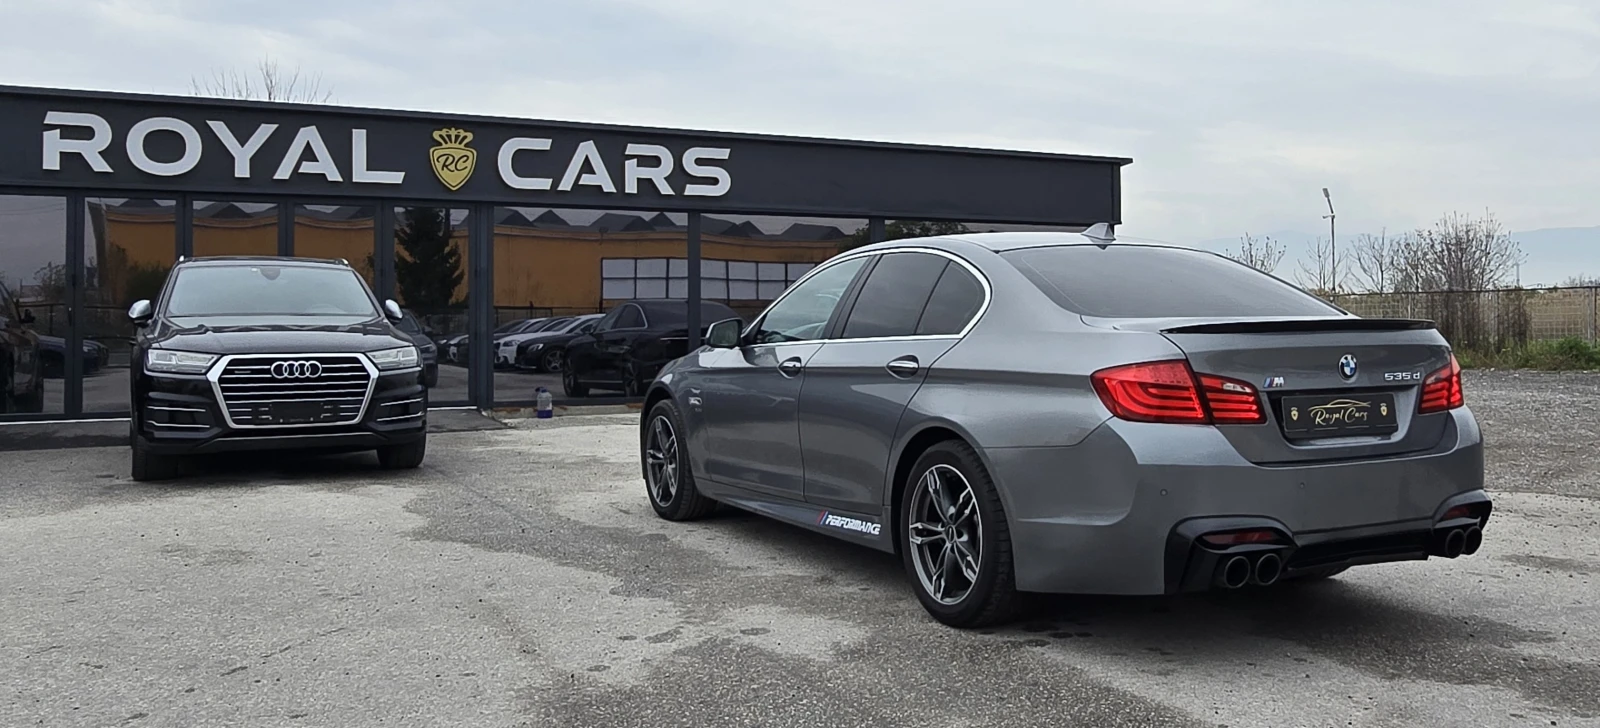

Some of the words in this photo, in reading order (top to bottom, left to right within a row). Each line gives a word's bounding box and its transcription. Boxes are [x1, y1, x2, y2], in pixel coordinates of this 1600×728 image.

[42, 111, 405, 184] ROYAL
[498, 138, 732, 196] CARS
[436, 151, 470, 173] RC
[1310, 408, 1343, 425] Royal
[1345, 408, 1368, 423] Cars
[825, 514, 881, 535] PERFORMANCE
